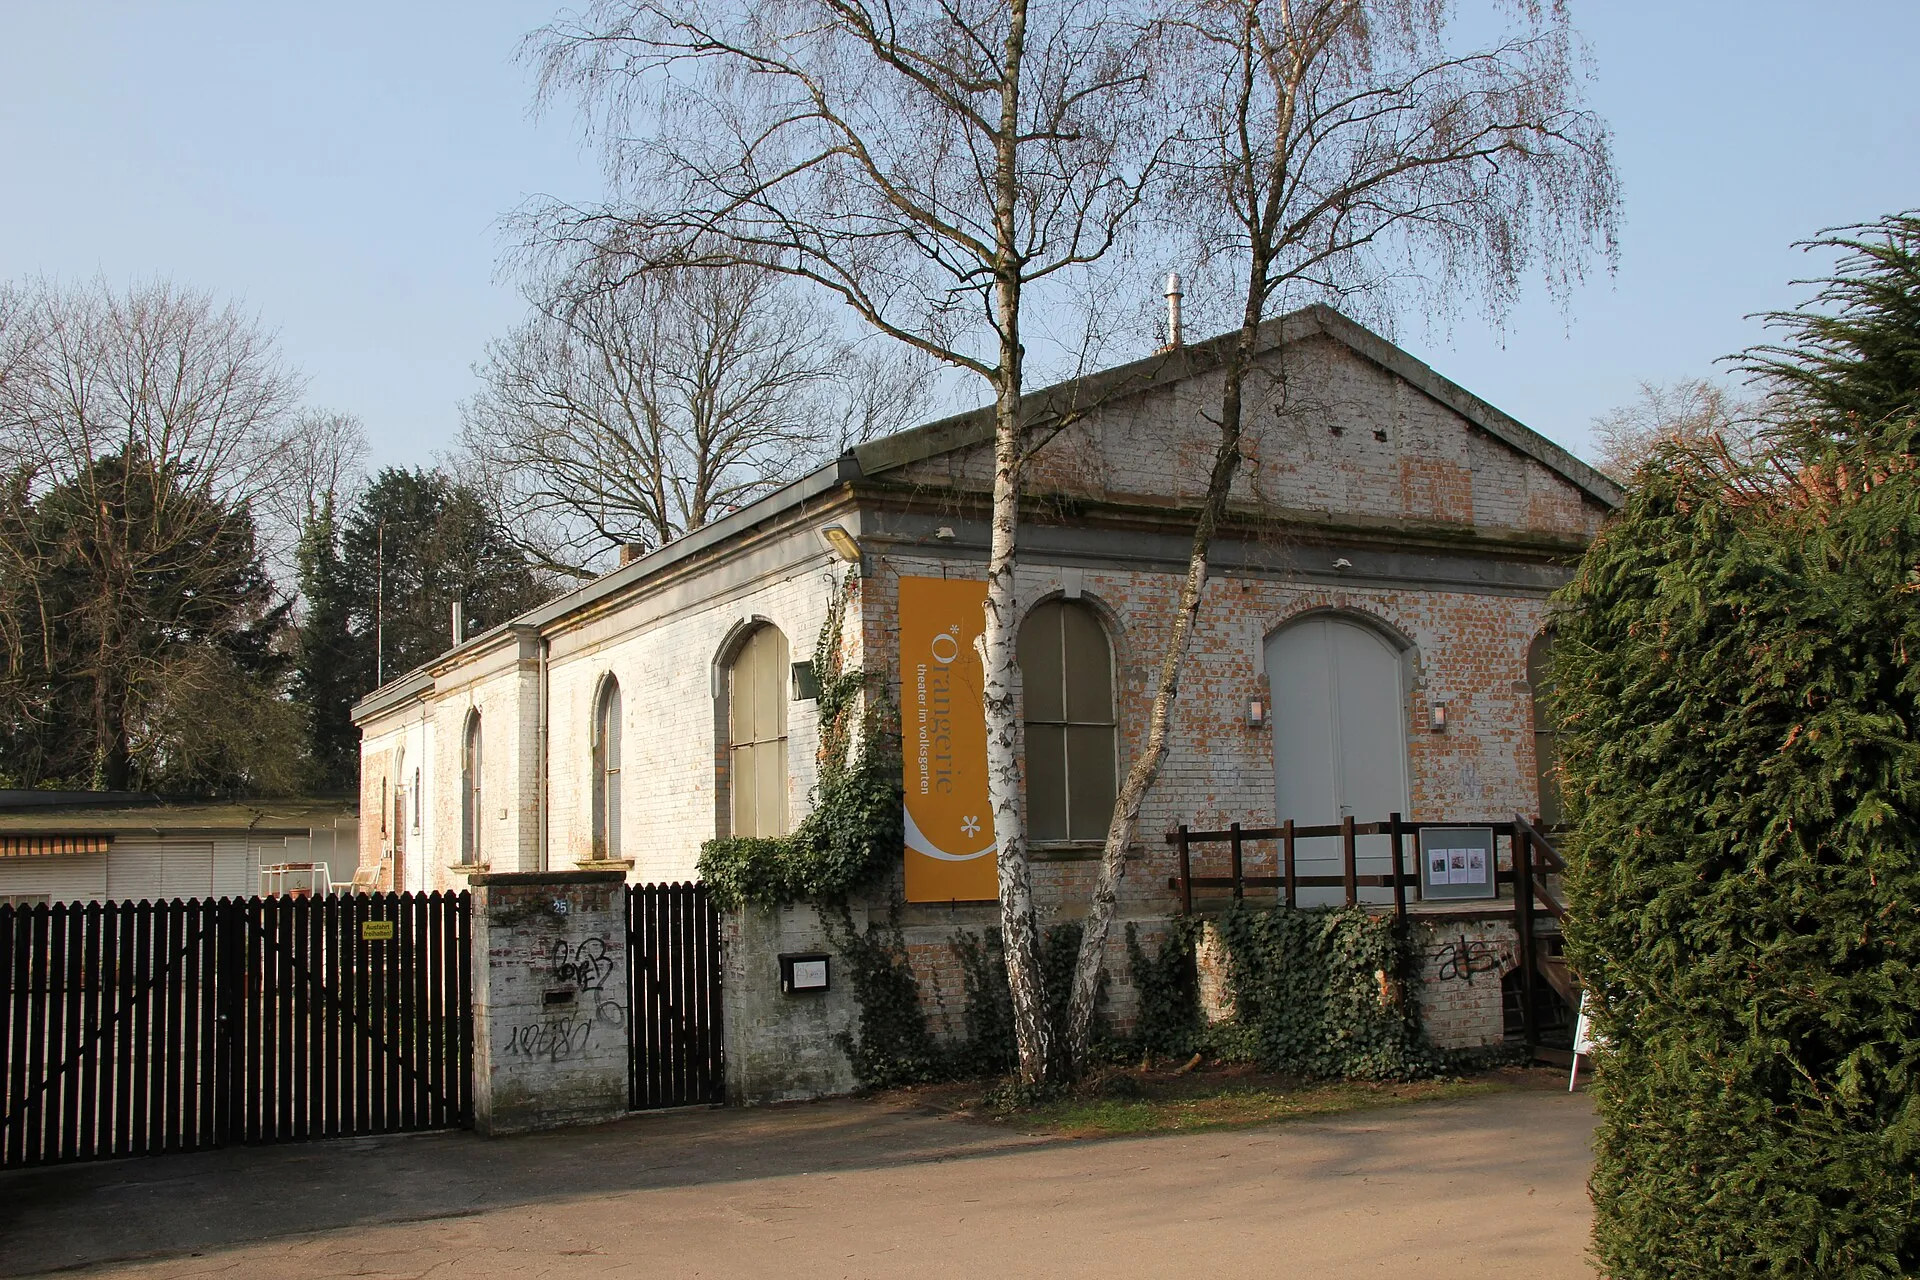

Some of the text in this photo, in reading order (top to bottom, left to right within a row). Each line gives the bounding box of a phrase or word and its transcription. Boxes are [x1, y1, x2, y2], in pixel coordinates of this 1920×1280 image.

[916, 663, 930, 795] theater im volksgarten
[929, 633, 961, 795] Orangerie
[553, 902, 567, 913] 25
